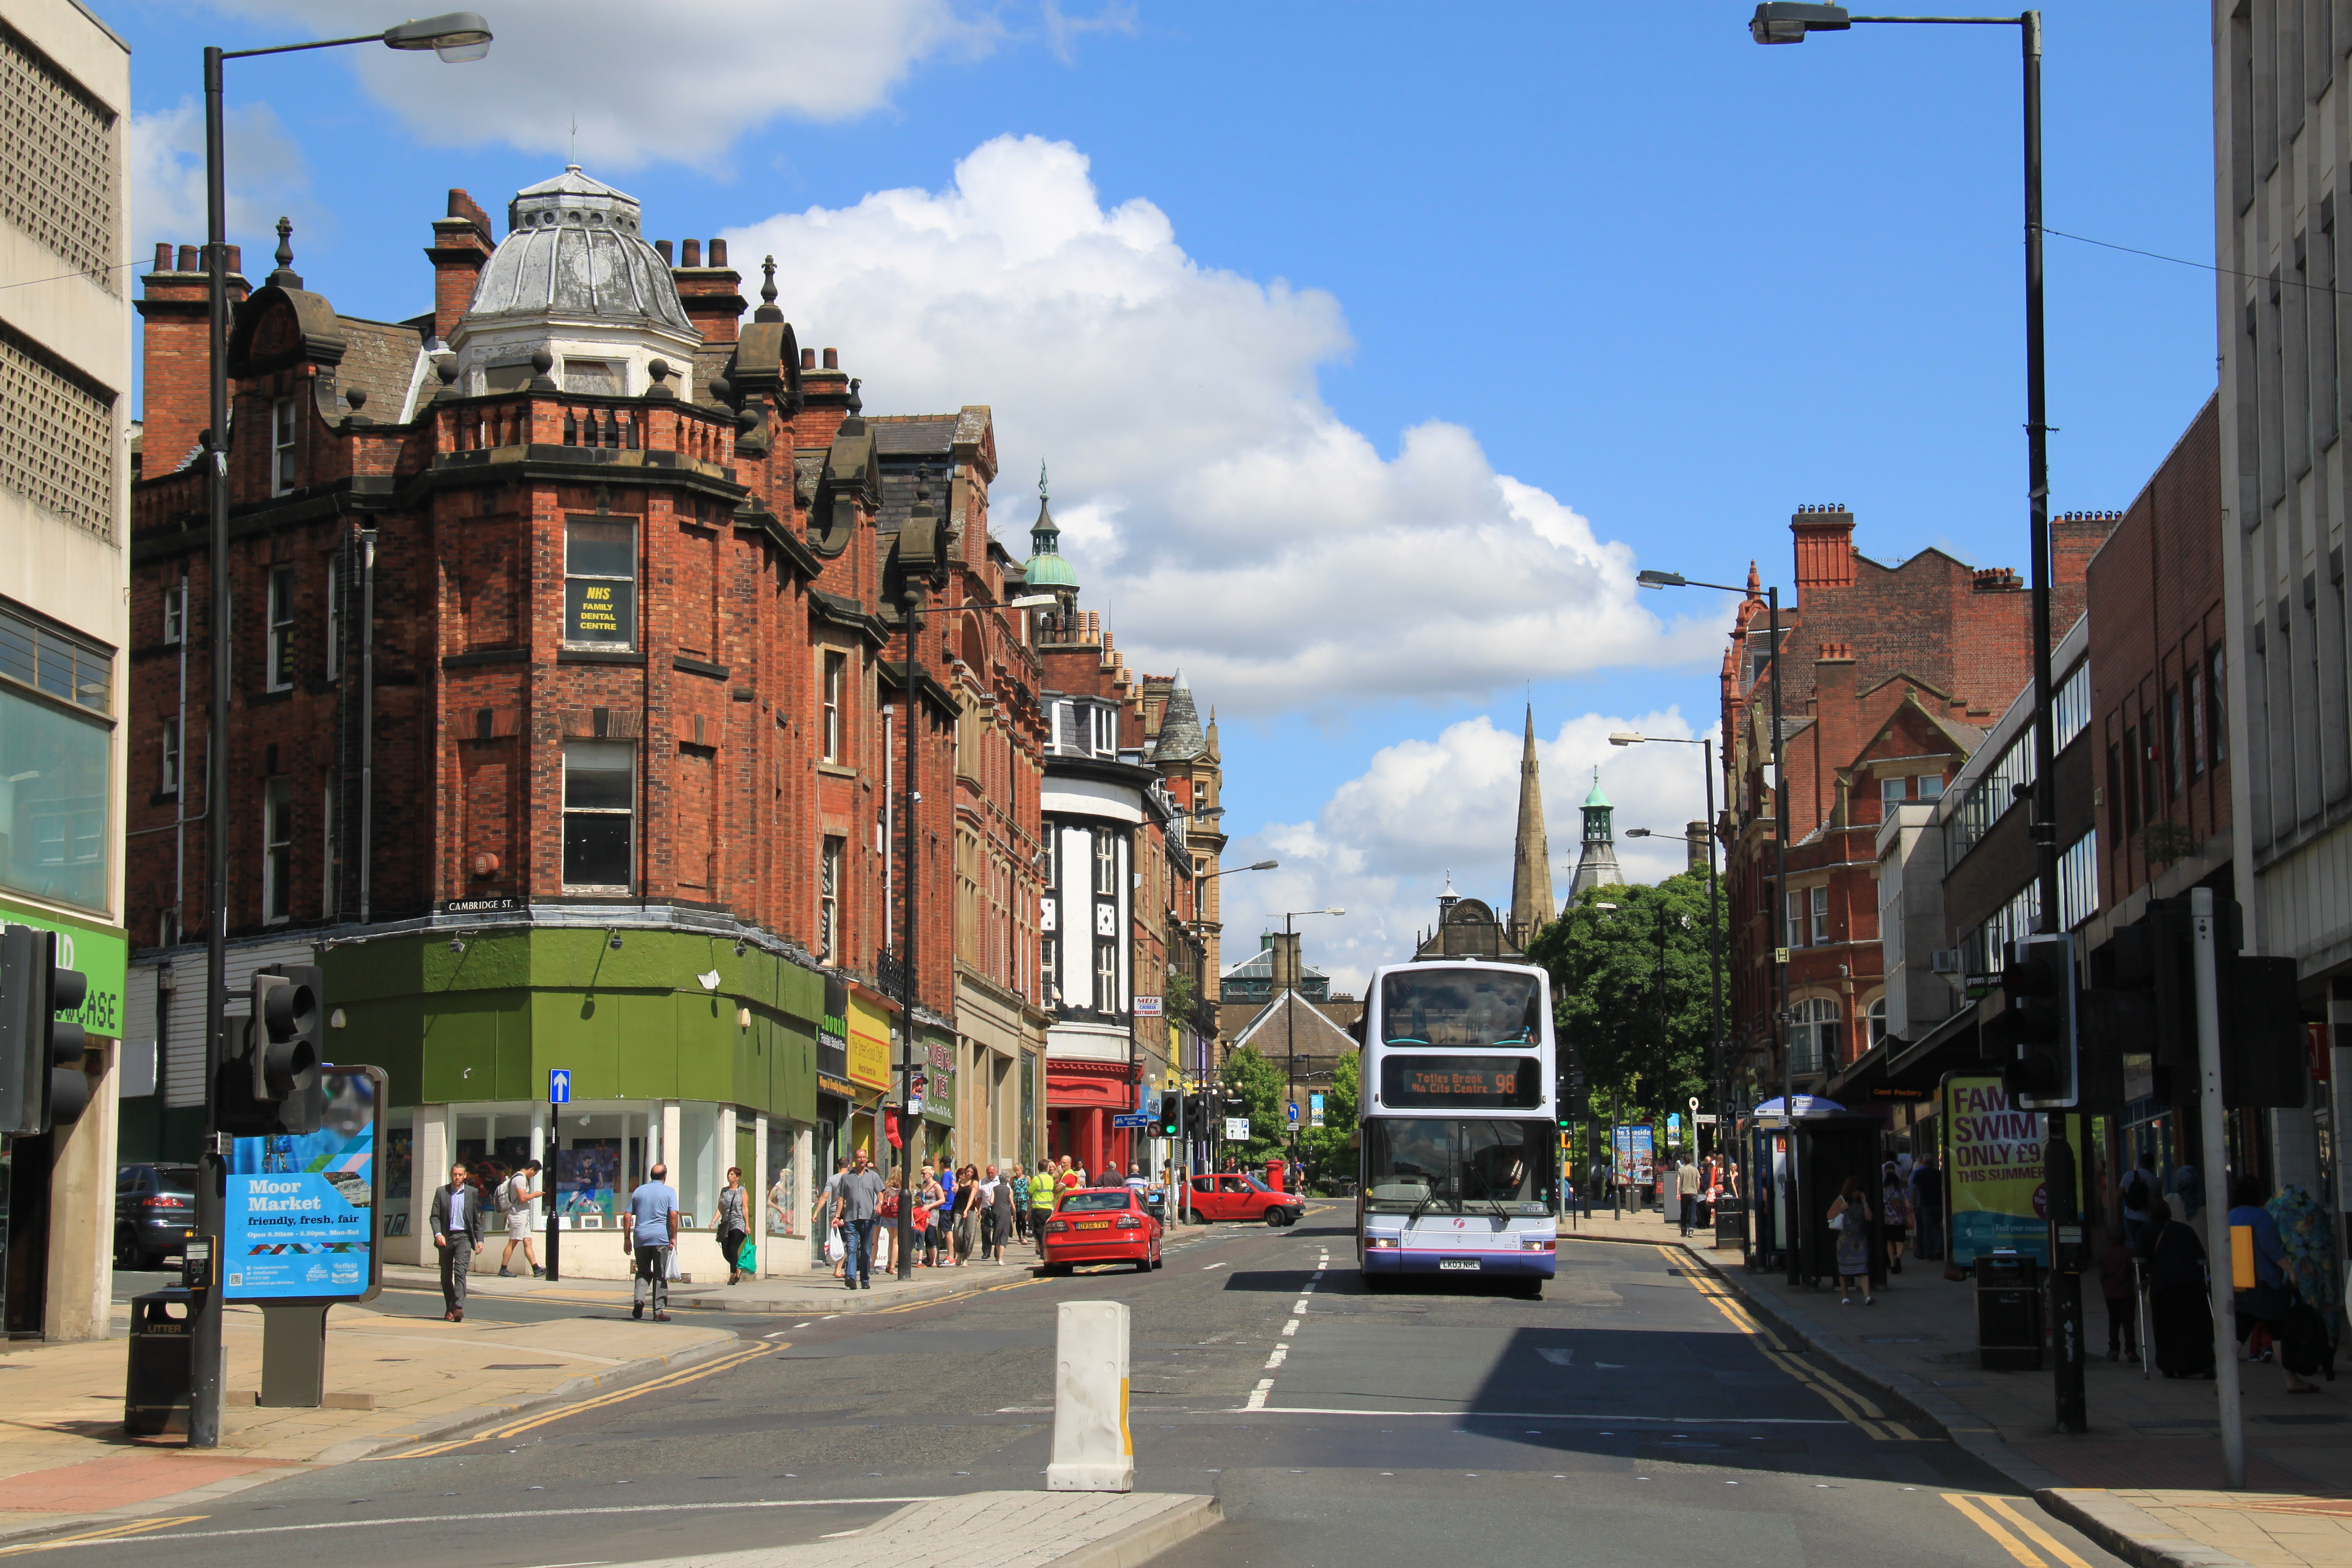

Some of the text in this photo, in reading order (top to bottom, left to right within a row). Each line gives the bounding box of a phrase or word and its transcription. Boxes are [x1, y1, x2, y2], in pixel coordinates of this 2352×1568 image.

[587, 587, 611, 600] NHS
[449, 899, 513, 911] CAMBRIDGE ST.
[822, 1014, 845, 1038] noush
[1416, 1073, 1482, 1083] Totley Brook
[1496, 1074, 1515, 1094] 98
[1430, 1083, 1450, 1093] City
[1454, 1083, 1488, 1093] Centre
[1894, 1089, 1922, 1097] Factory
[1955, 1113, 2037, 1143] SWIM
[1956, 1143, 2011, 1167] ONLY
[1957, 1167, 2046, 1183] THIS SUMMER
[249, 1180, 301, 1194] Moor
[248, 1196, 321, 1211] Market
[248, 1215, 359, 1226] friendly, fresh, fair
